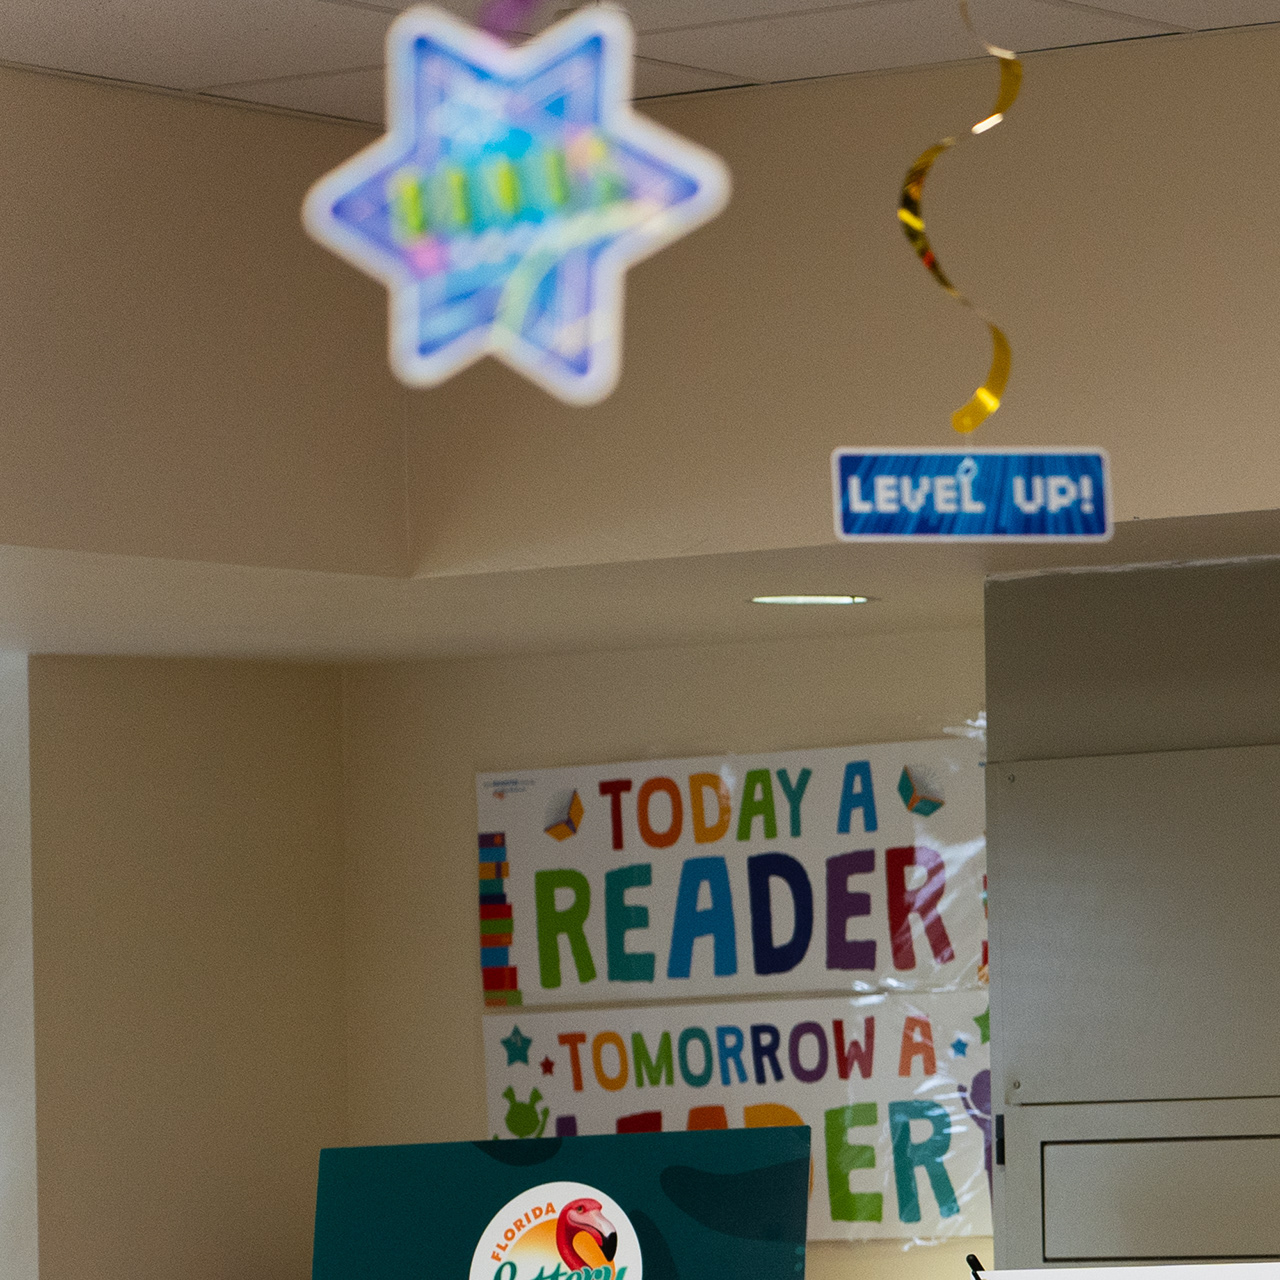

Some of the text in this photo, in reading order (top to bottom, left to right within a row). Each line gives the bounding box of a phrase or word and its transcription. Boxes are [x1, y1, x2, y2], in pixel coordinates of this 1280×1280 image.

[848, 474, 1094, 514] LEVEL UP!
[599, 760, 878, 850] TODAY A
[534, 845, 955, 989] READER
[558, 1016, 937, 1092] TOMORROW A
[491, 1202, 556, 1262] FLORIDA
